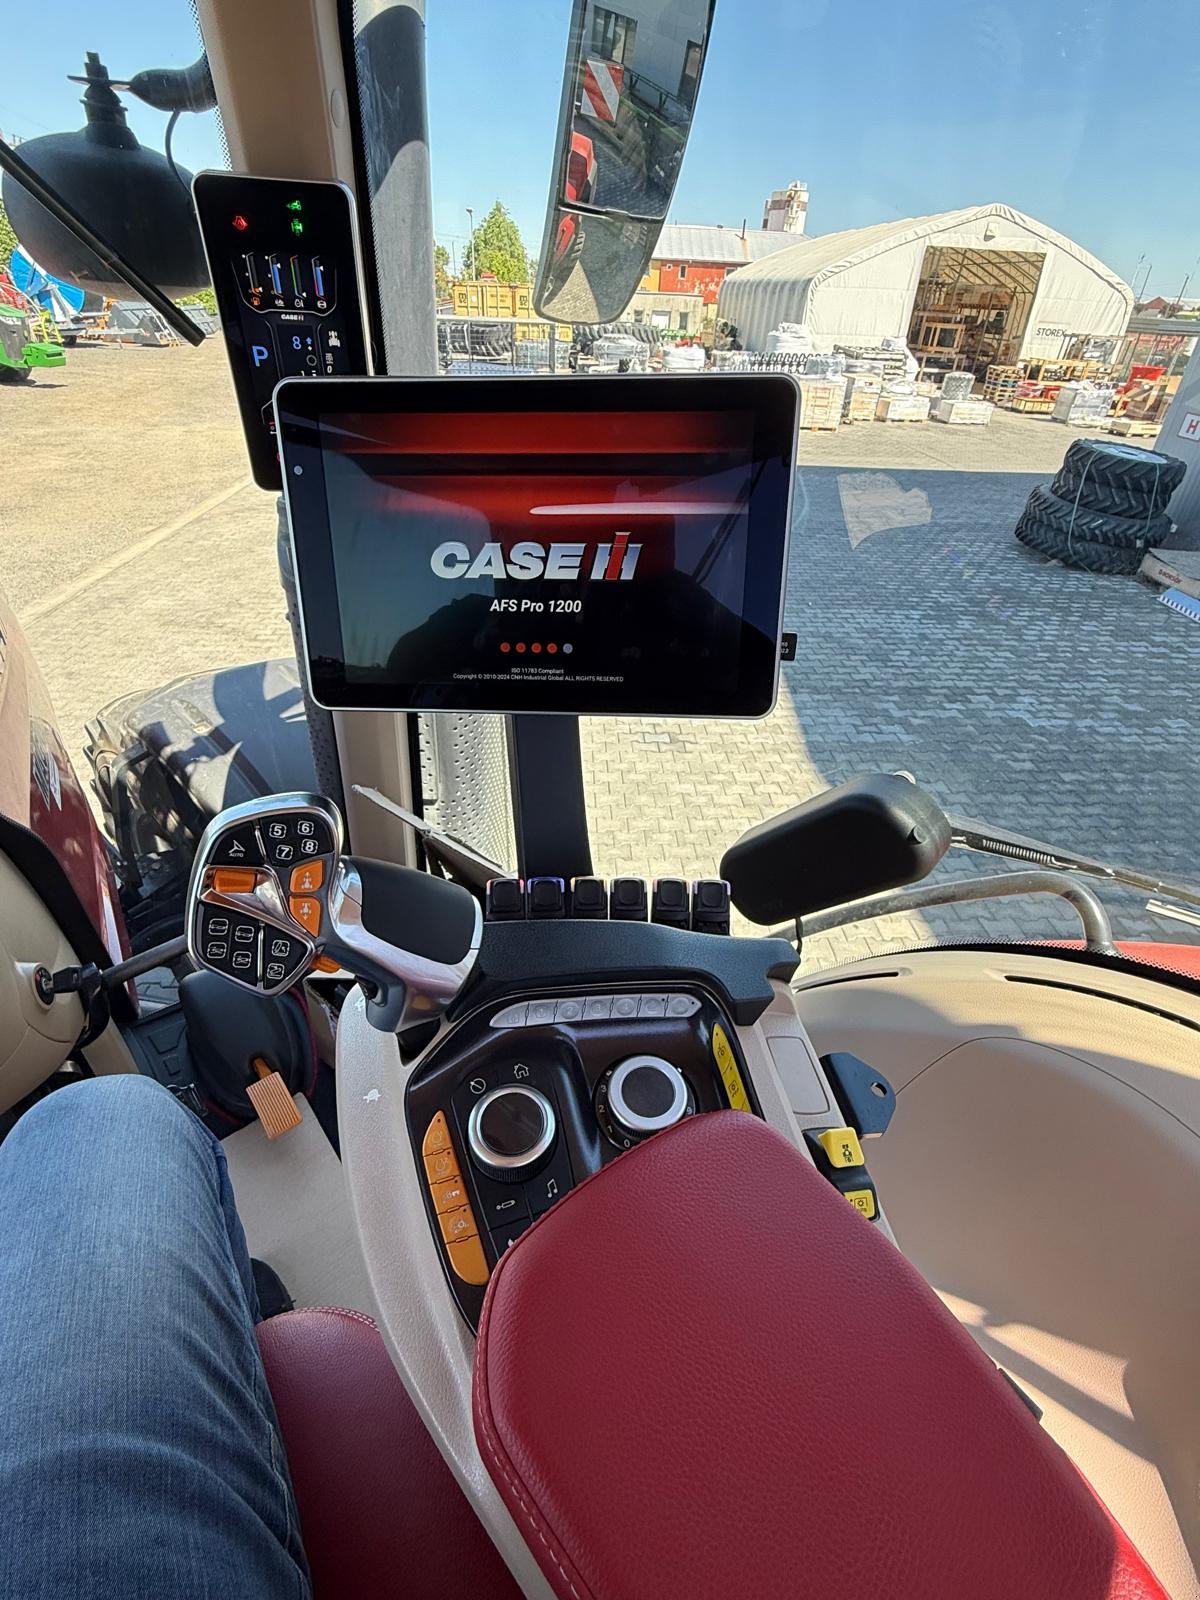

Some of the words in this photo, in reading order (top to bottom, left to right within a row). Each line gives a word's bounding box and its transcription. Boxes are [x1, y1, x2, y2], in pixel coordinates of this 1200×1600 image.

[281, 313, 298, 321] CASE
[292, 335, 302, 350] 8
[251, 345, 269, 367] P
[326, 365, 333, 374] 0
[430, 541, 587, 580] CASE
[489, 599, 518, 613] AFS
[520, 600, 544, 613] Pro
[548, 600, 582, 613] 1200
[538, 667, 564, 676] Compliant
[273, 825, 282, 837] 5
[301, 824, 310, 835] 6
[280, 847, 289, 859] 7
[305, 841, 314, 852] 8
[600, 1085, 607, 1093] 3
[598, 1104, 606, 1113] 2
[623, 1138, 631, 1148] 0
